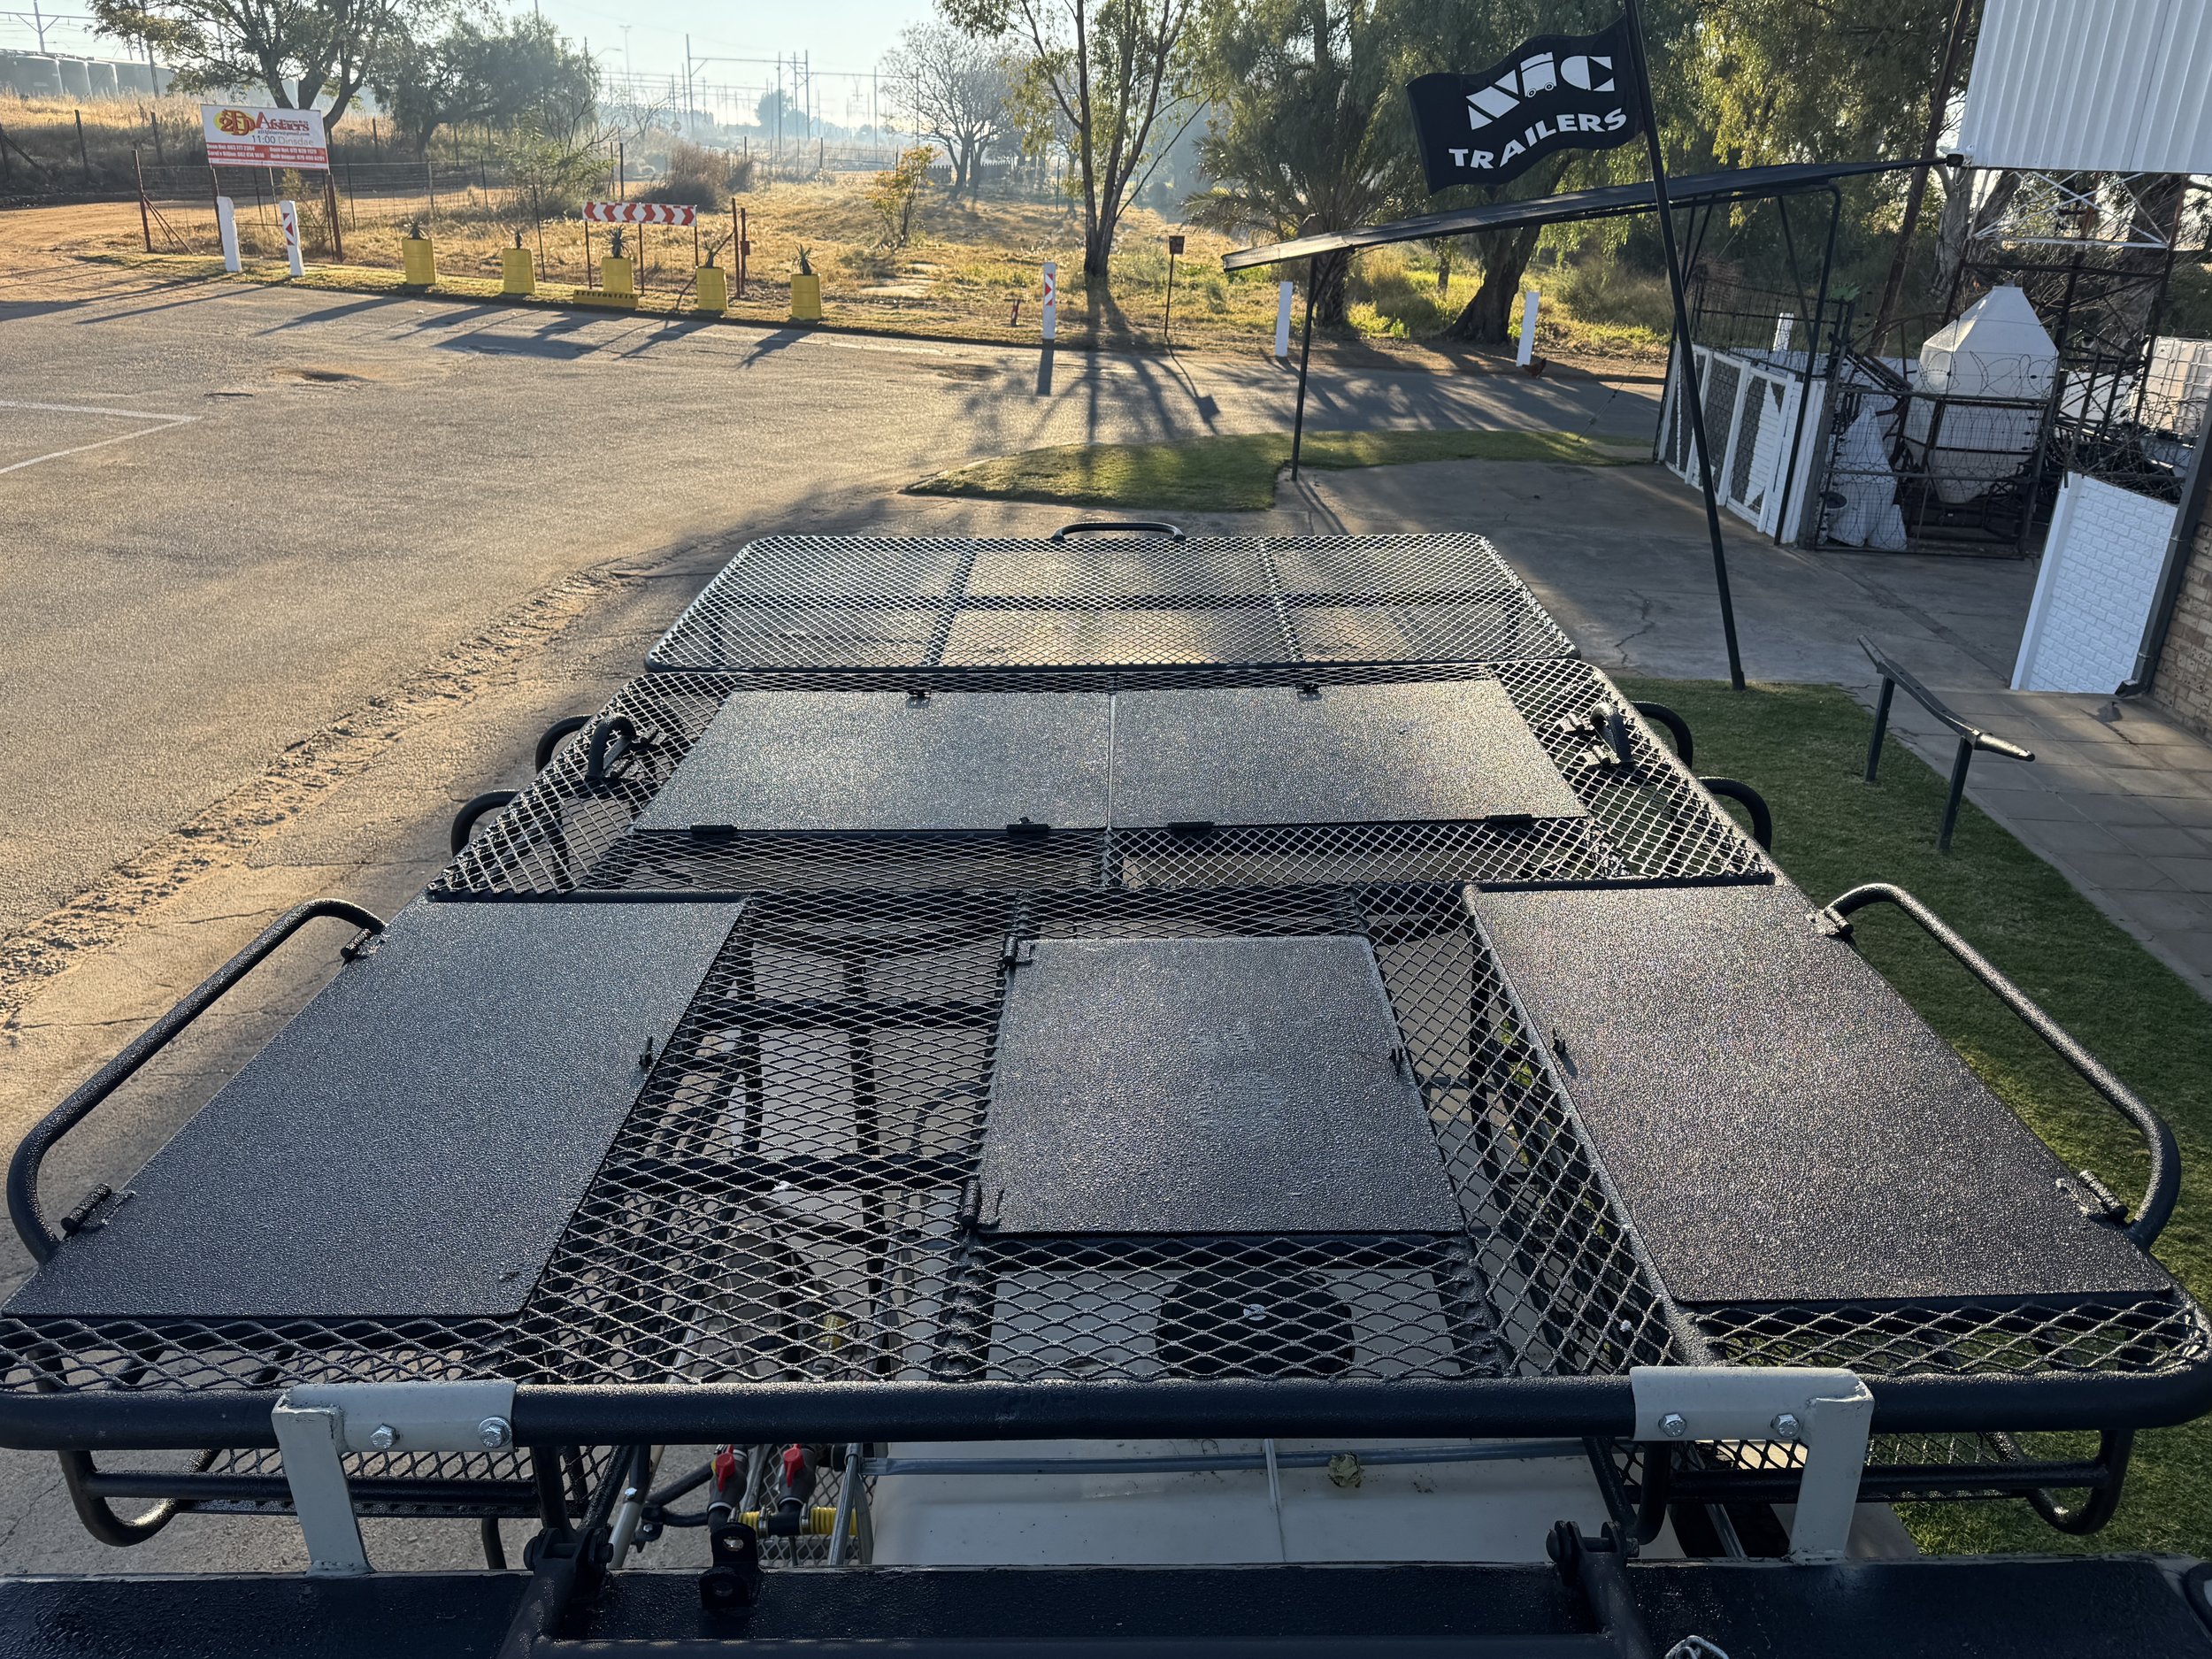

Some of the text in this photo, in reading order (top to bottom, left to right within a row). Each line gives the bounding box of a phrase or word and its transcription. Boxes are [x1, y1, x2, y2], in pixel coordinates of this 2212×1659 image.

[252, 134, 314, 147] 11:00 Dinsdae
[1448, 107, 1627, 169] TRAILERS
